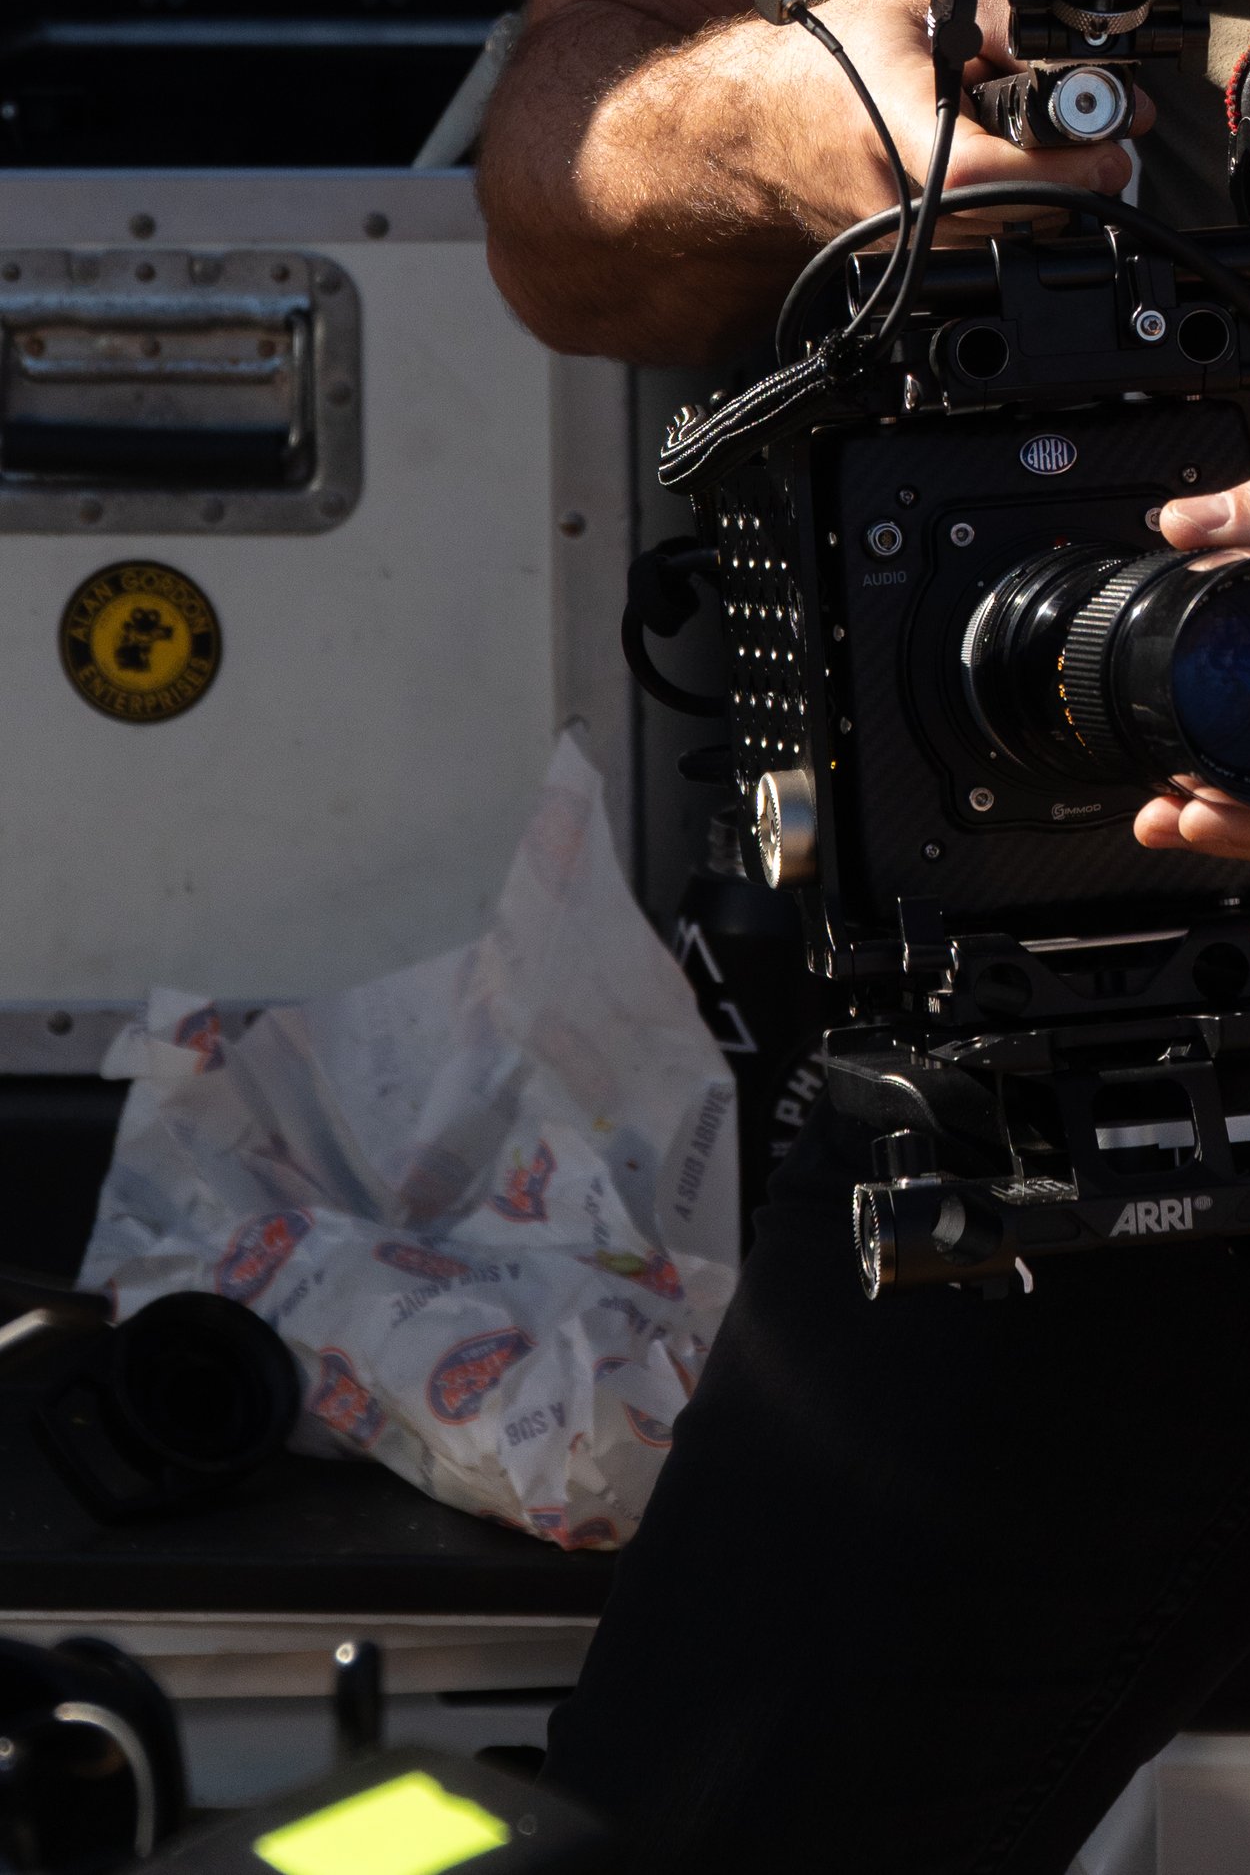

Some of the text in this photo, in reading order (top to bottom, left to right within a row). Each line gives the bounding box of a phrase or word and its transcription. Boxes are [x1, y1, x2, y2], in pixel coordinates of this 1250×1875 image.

[1027, 438, 1069, 471] ARRI
[862, 570, 907, 587] AUDIO
[69, 573, 210, 641] ALAN GORDON
[79, 657, 211, 713] ENTERPRISES
[1108, 1196, 1193, 1238] ARRI
